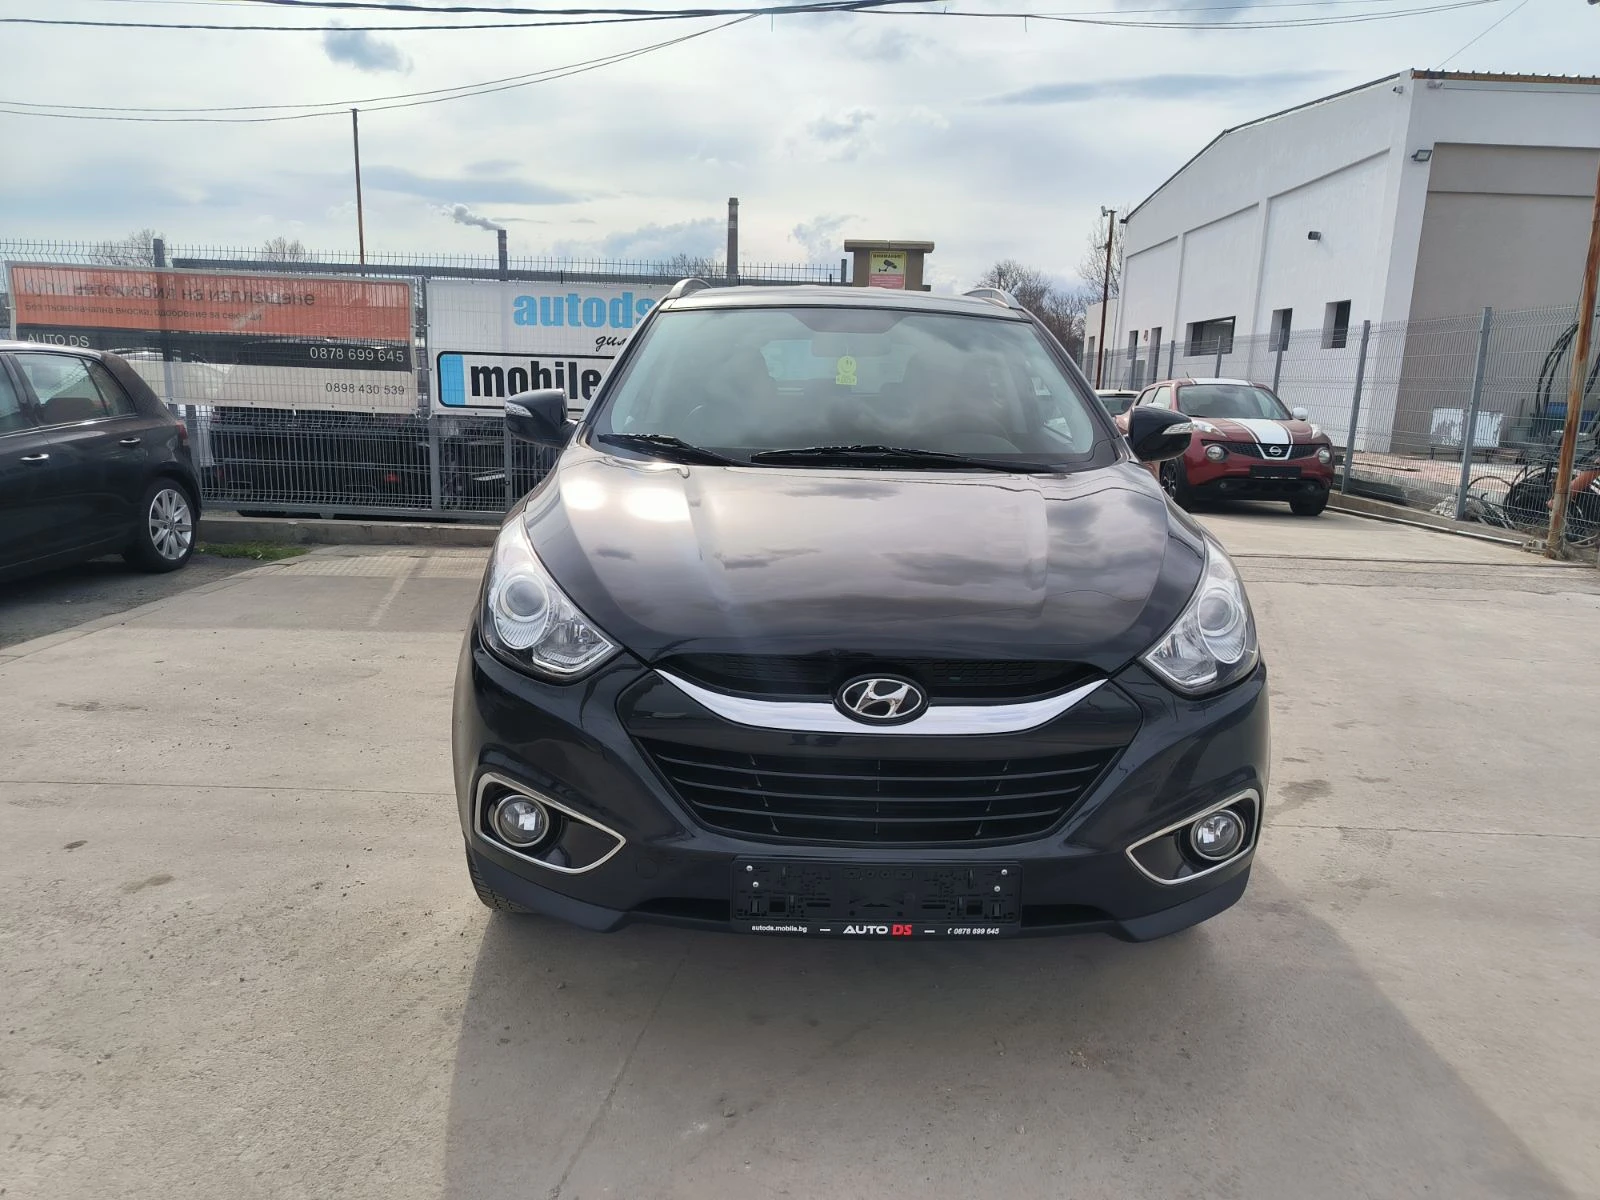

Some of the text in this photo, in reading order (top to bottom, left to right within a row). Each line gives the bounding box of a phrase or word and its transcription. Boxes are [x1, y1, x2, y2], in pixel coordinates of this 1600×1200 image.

[182, 287, 203, 301] на
[209, 288, 315, 306] изплащане
[209, 311, 220, 320] за
[27, 333, 90, 348] AUTO DS
[310, 347, 404, 362] 0878 699 645
[325, 382, 405, 396] 0898 430 539
[843, 925, 889, 935] AUTO
[892, 924, 913, 936] DS
[953, 927, 971, 935] 0878
[972, 927, 986, 935] 699
[986, 927, 1000, 935] 645
